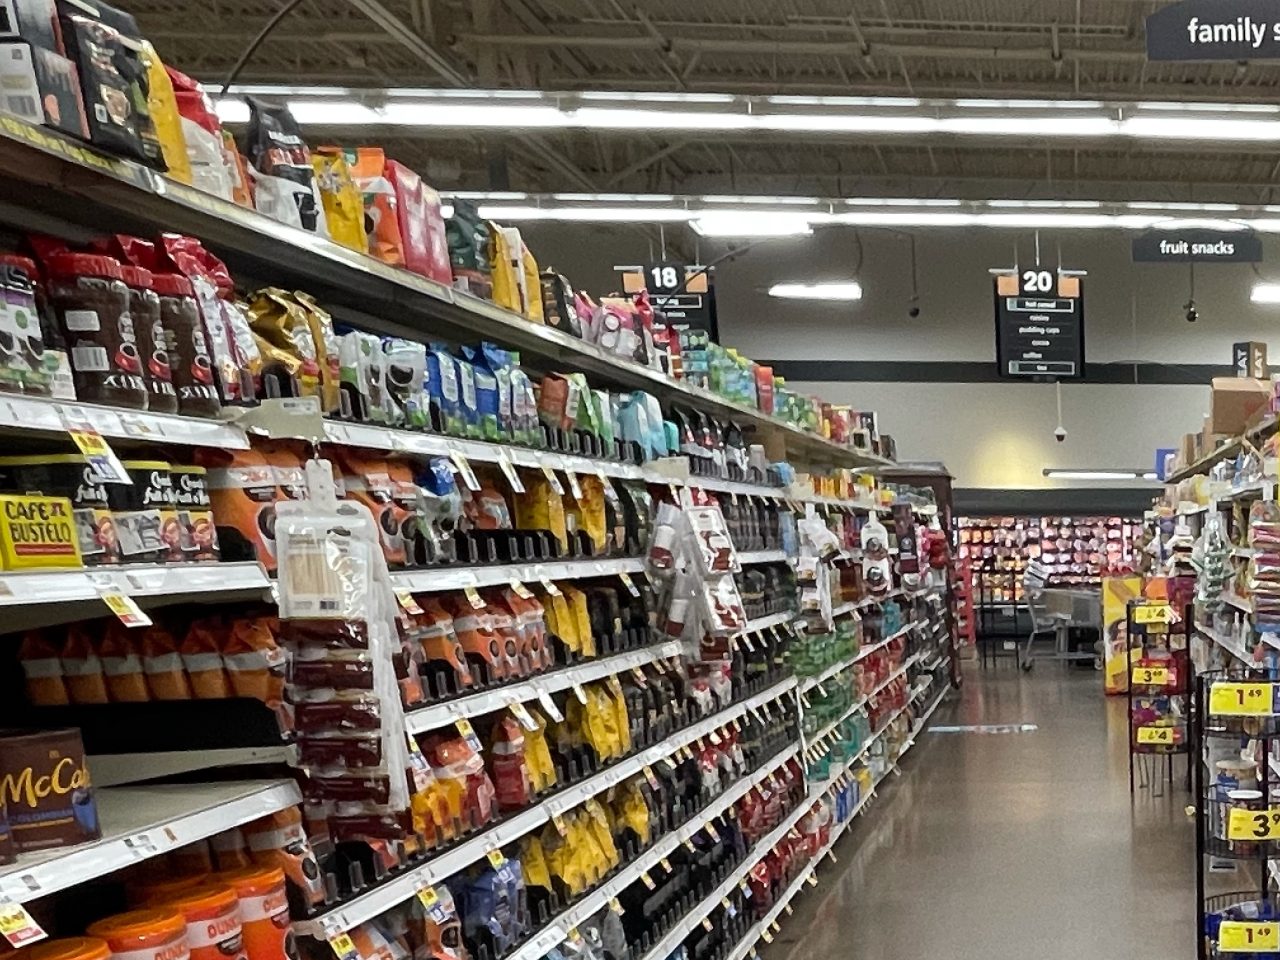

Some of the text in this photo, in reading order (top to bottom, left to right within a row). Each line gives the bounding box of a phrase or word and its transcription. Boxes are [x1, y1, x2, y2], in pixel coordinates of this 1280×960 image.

[1187, 16, 1266, 48] family
[1159, 239, 1235, 255] fruit snacks
[651, 266, 678, 289] 18
[1023, 270, 1053, 292] 20
[10, 521, 73, 544] BUSTELO
[0, 757, 92, 808] McCa
